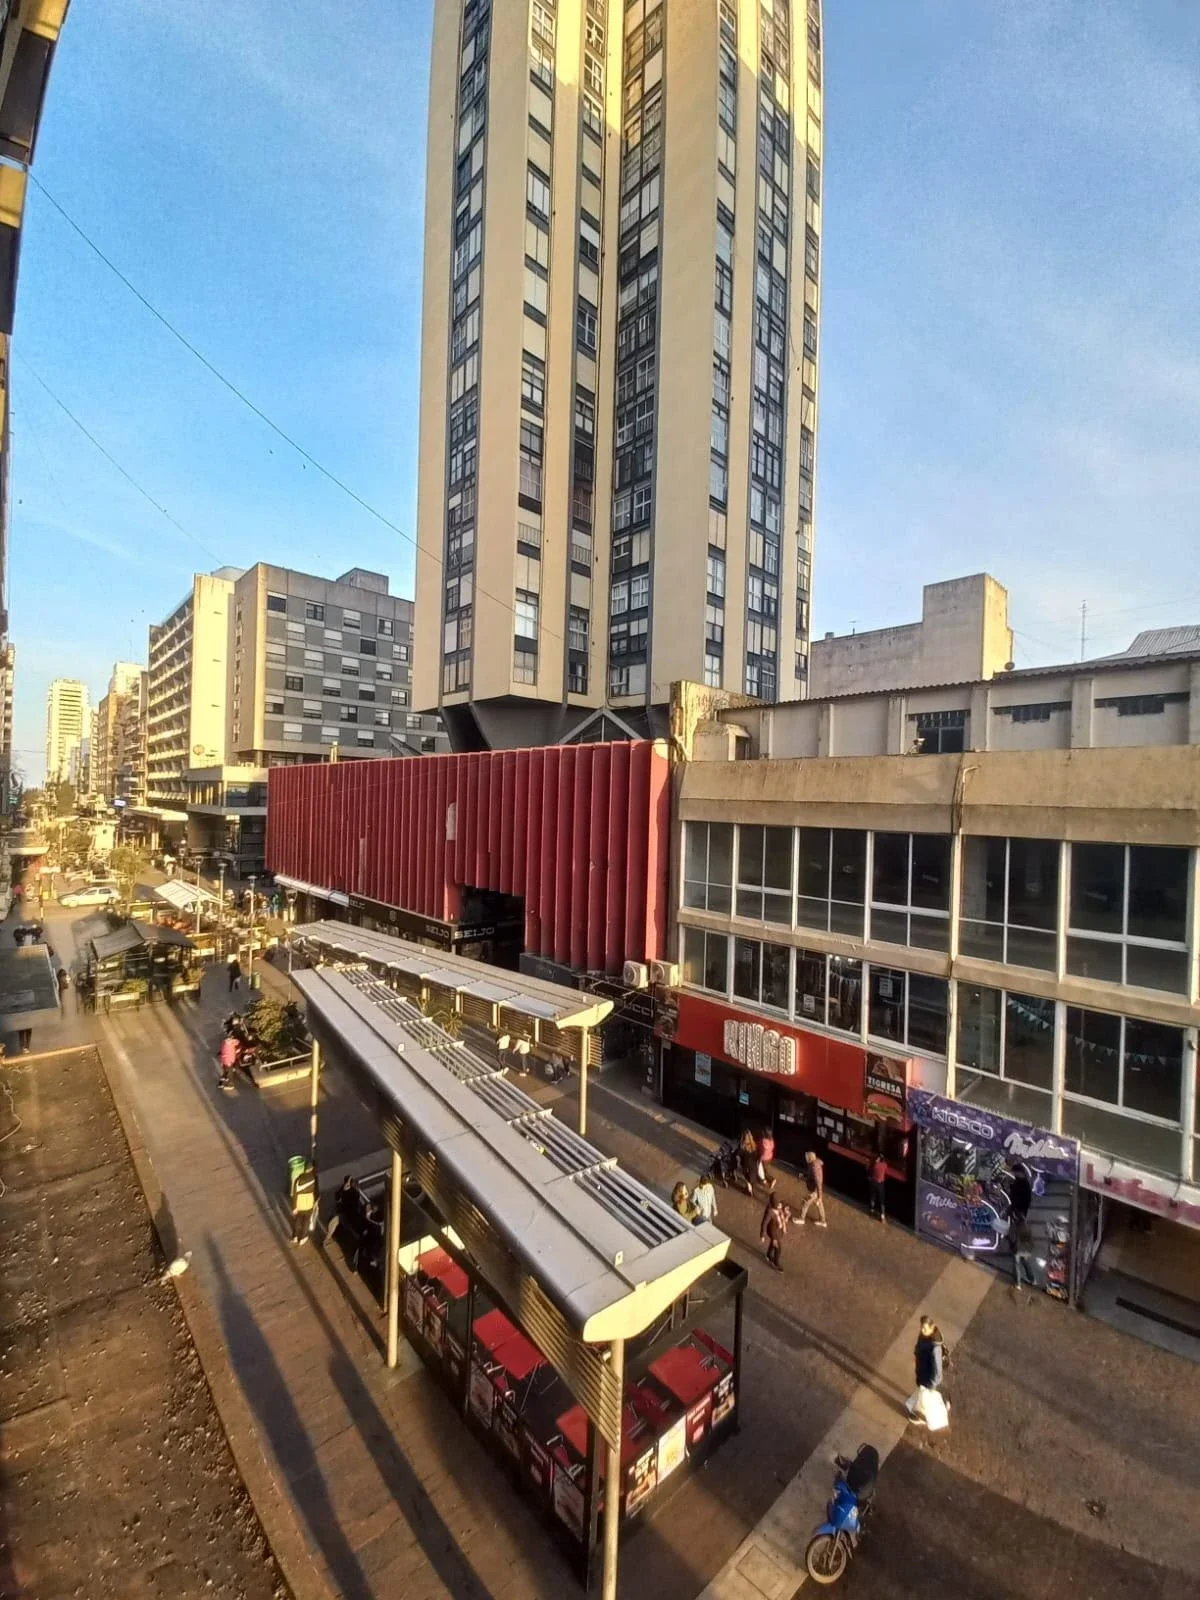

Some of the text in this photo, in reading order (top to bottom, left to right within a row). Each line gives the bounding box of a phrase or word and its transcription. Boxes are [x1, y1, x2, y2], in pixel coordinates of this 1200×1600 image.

[425, 924, 450, 939] SEIJO
[454, 926, 495, 940] SEIJO
[867, 1076, 902, 1095] TIGRESA
[931, 1106, 994, 1140] KIOSCO
[1004, 1132, 1069, 1159] Milka
[926, 1192, 958, 1209] Milka
